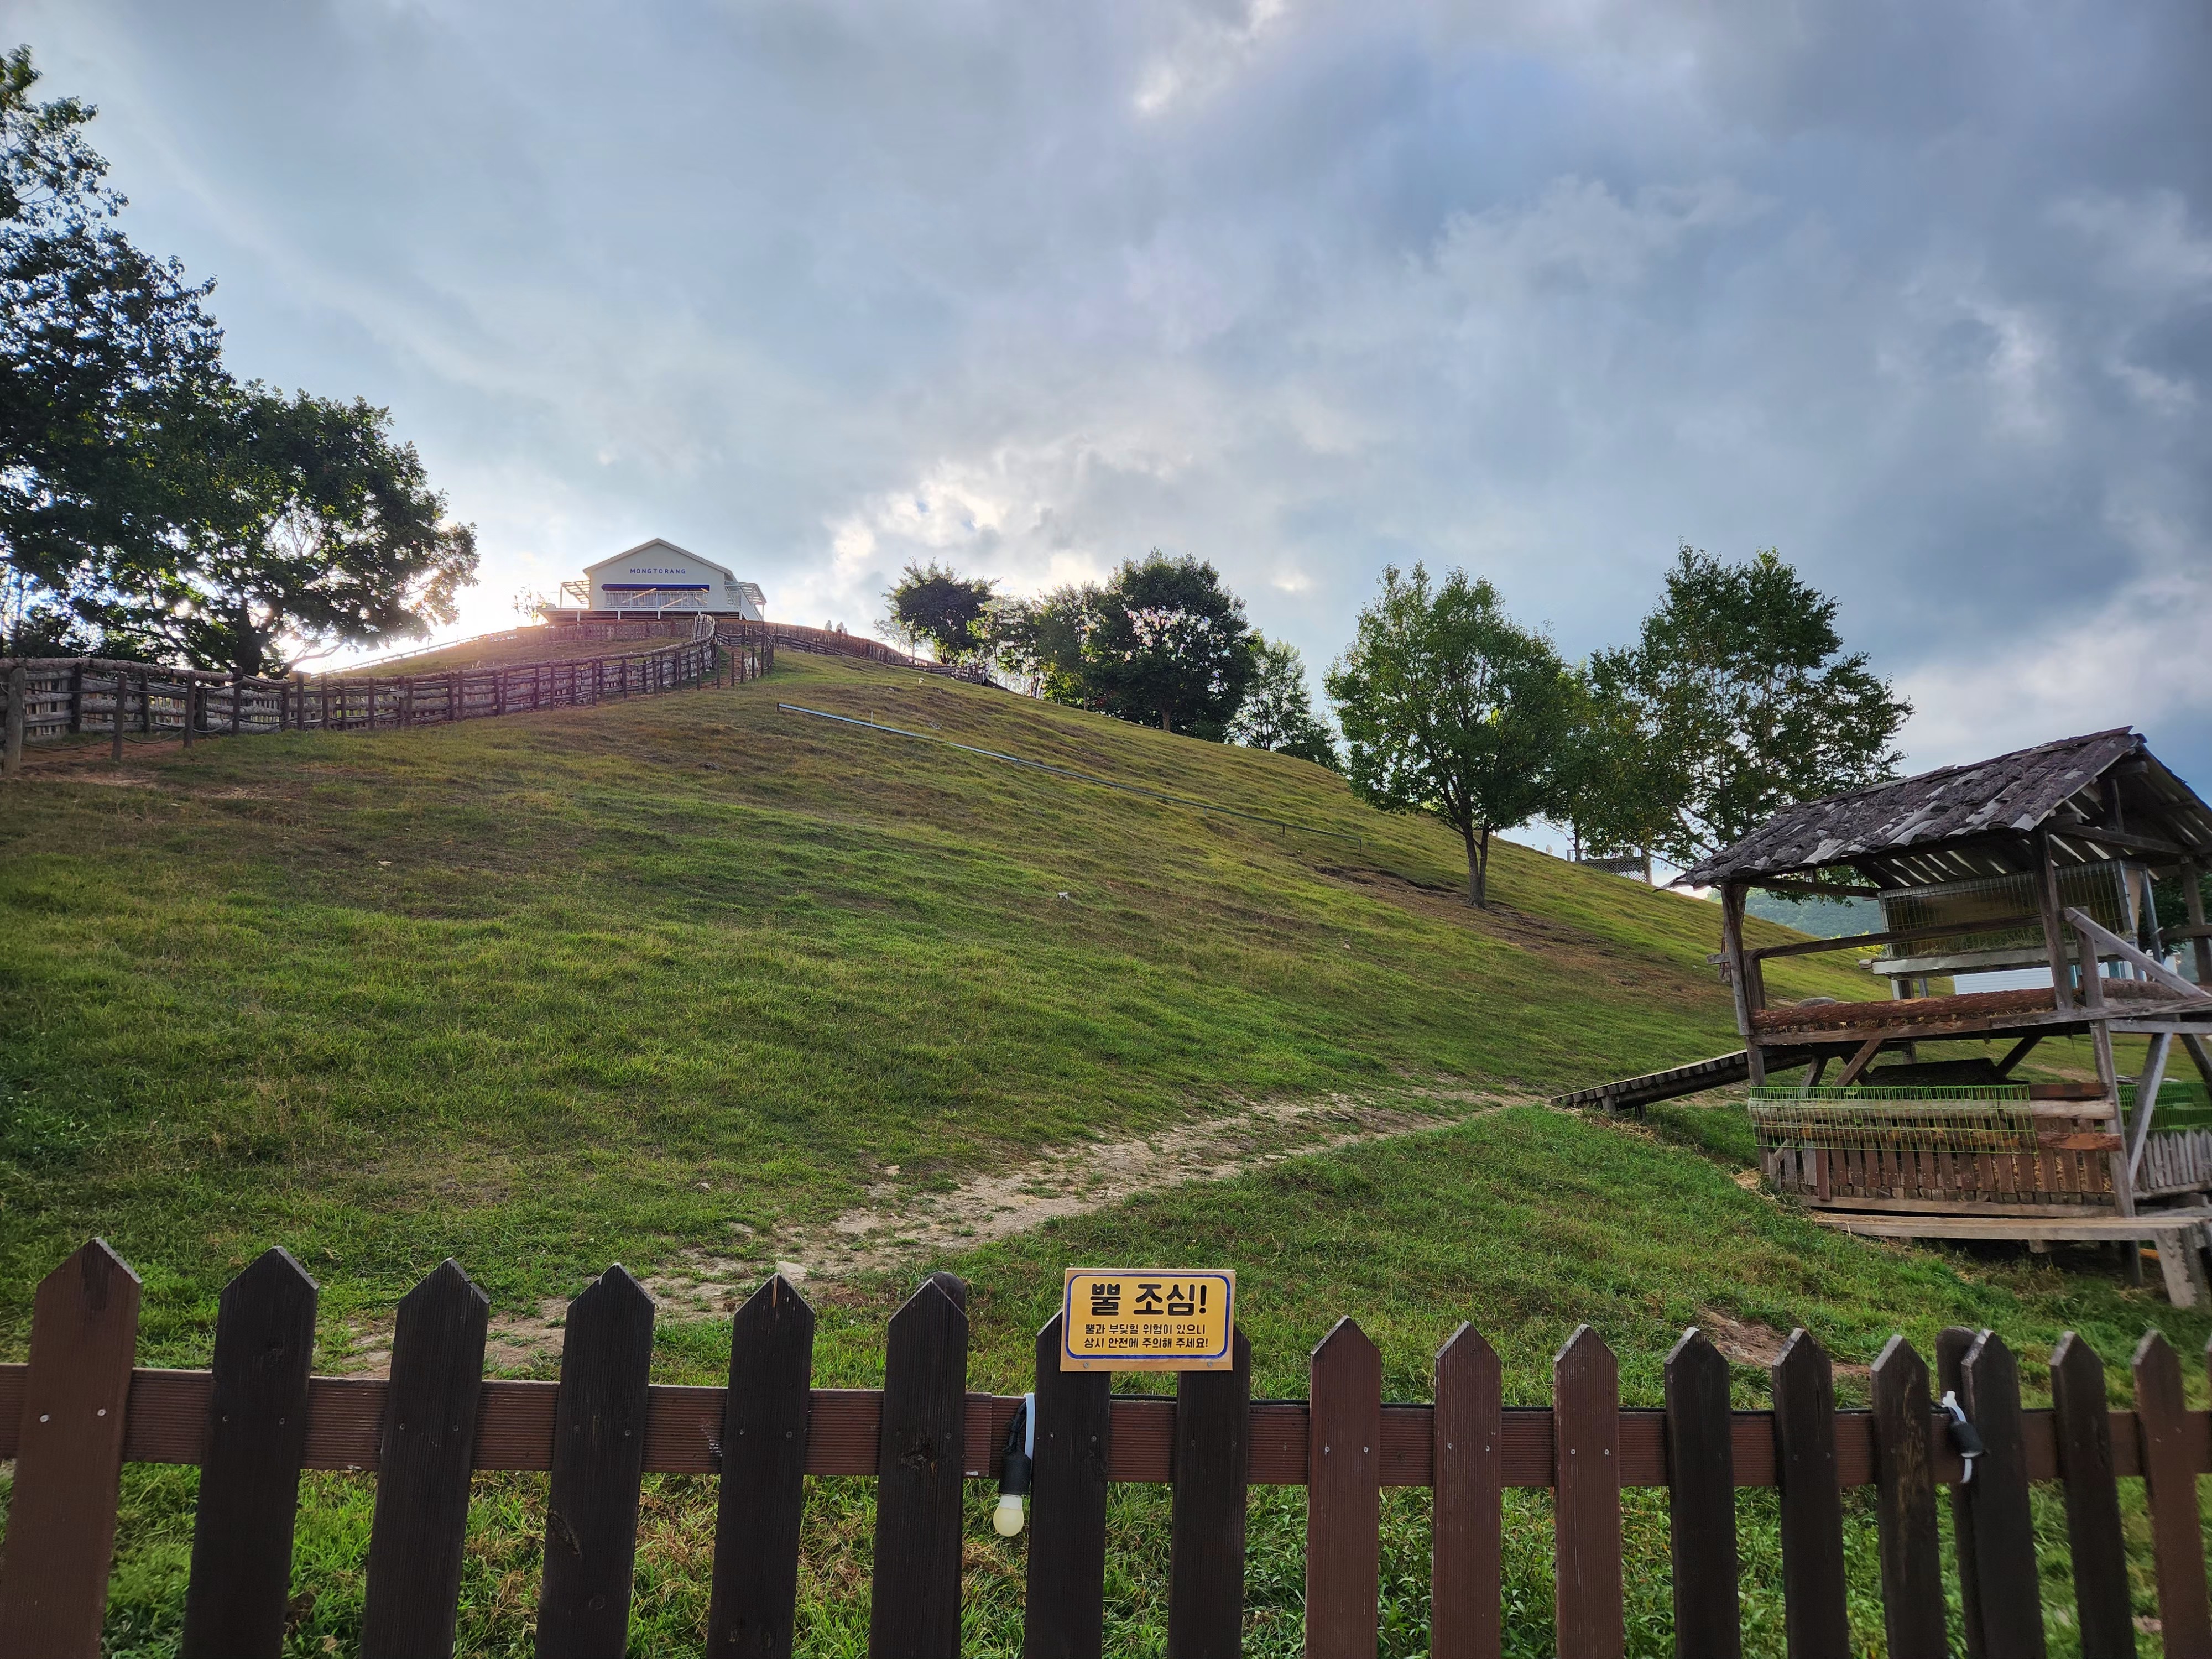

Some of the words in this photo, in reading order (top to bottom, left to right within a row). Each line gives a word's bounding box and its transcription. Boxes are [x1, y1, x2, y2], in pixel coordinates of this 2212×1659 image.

[1089, 1283, 1121, 1316] 뿔
[1133, 1283, 1207, 1316] 조심!
[1084, 1324, 1105, 1334] 뿔과
[1109, 1324, 1139, 1334] 부딪힐
[1142, 1324, 1172, 1334] 위험이
[1176, 1324, 1206, 1334] 있으니
[1084, 1337, 1104, 1348] 상시
[1108, 1338, 1139, 1348] 안전에
[1142, 1338, 1172, 1348] 주의해
[1176, 1338, 1208, 1348] 주세요!
